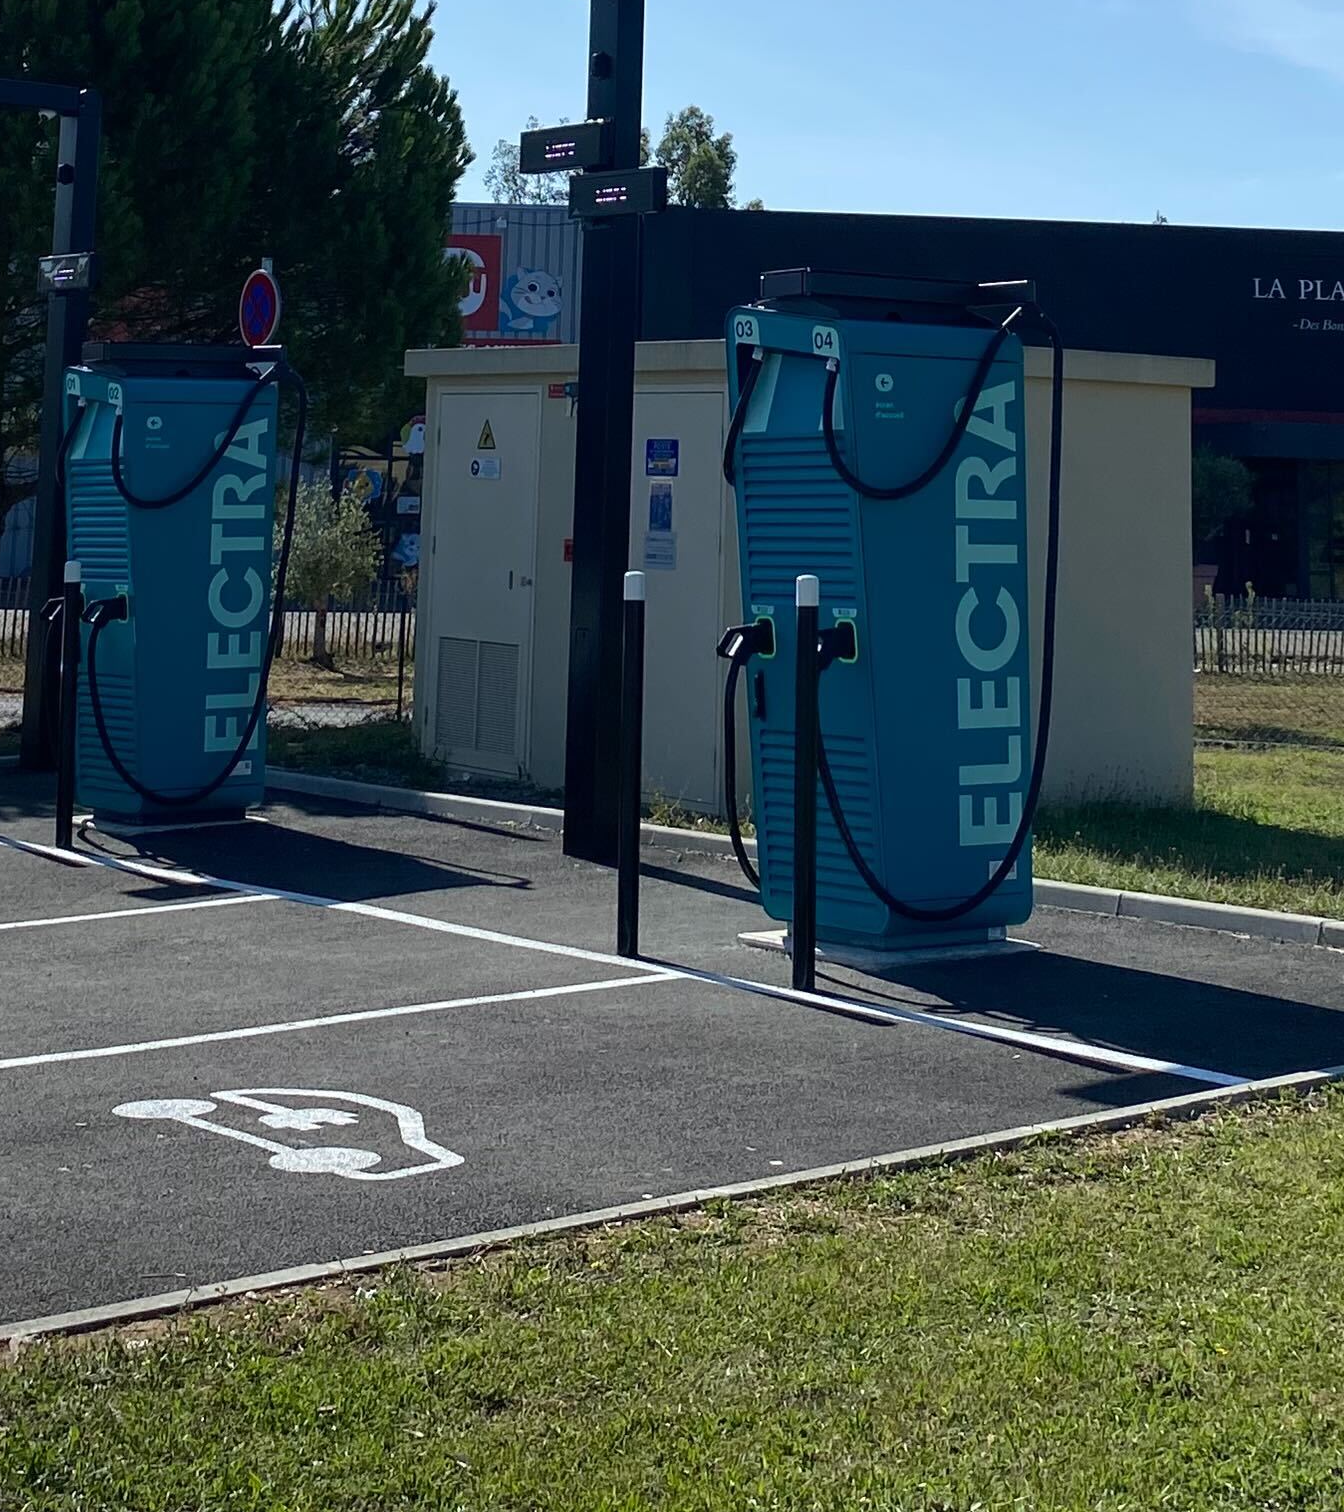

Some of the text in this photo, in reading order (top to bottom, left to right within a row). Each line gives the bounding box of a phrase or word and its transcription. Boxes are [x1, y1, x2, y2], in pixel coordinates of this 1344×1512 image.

[1252, 278, 1286, 299] LA
[736, 320, 753, 337] 03
[814, 331, 833, 350] 04
[66, 377, 77, 390] 01
[109, 387, 120, 400] 02
[204, 418, 268, 753] ELECTRA
[954, 381, 1023, 848] ELECTRA
